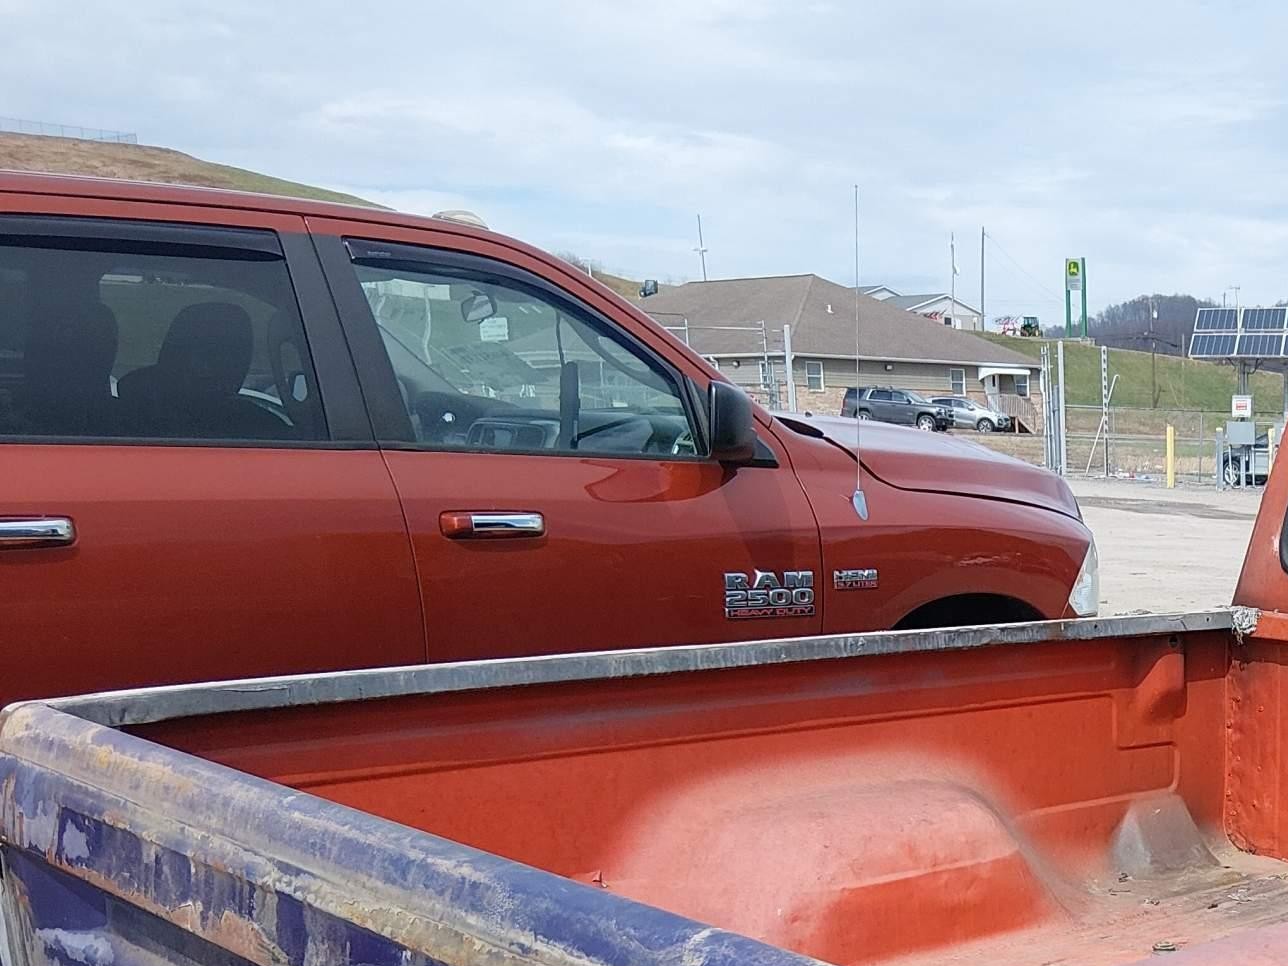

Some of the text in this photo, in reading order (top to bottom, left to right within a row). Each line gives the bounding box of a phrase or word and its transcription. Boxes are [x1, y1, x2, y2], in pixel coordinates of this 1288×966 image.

[724, 569, 814, 590] RAM
[725, 588, 815, 607] 2500
[730, 607, 811, 618] HEAVY DUTY
